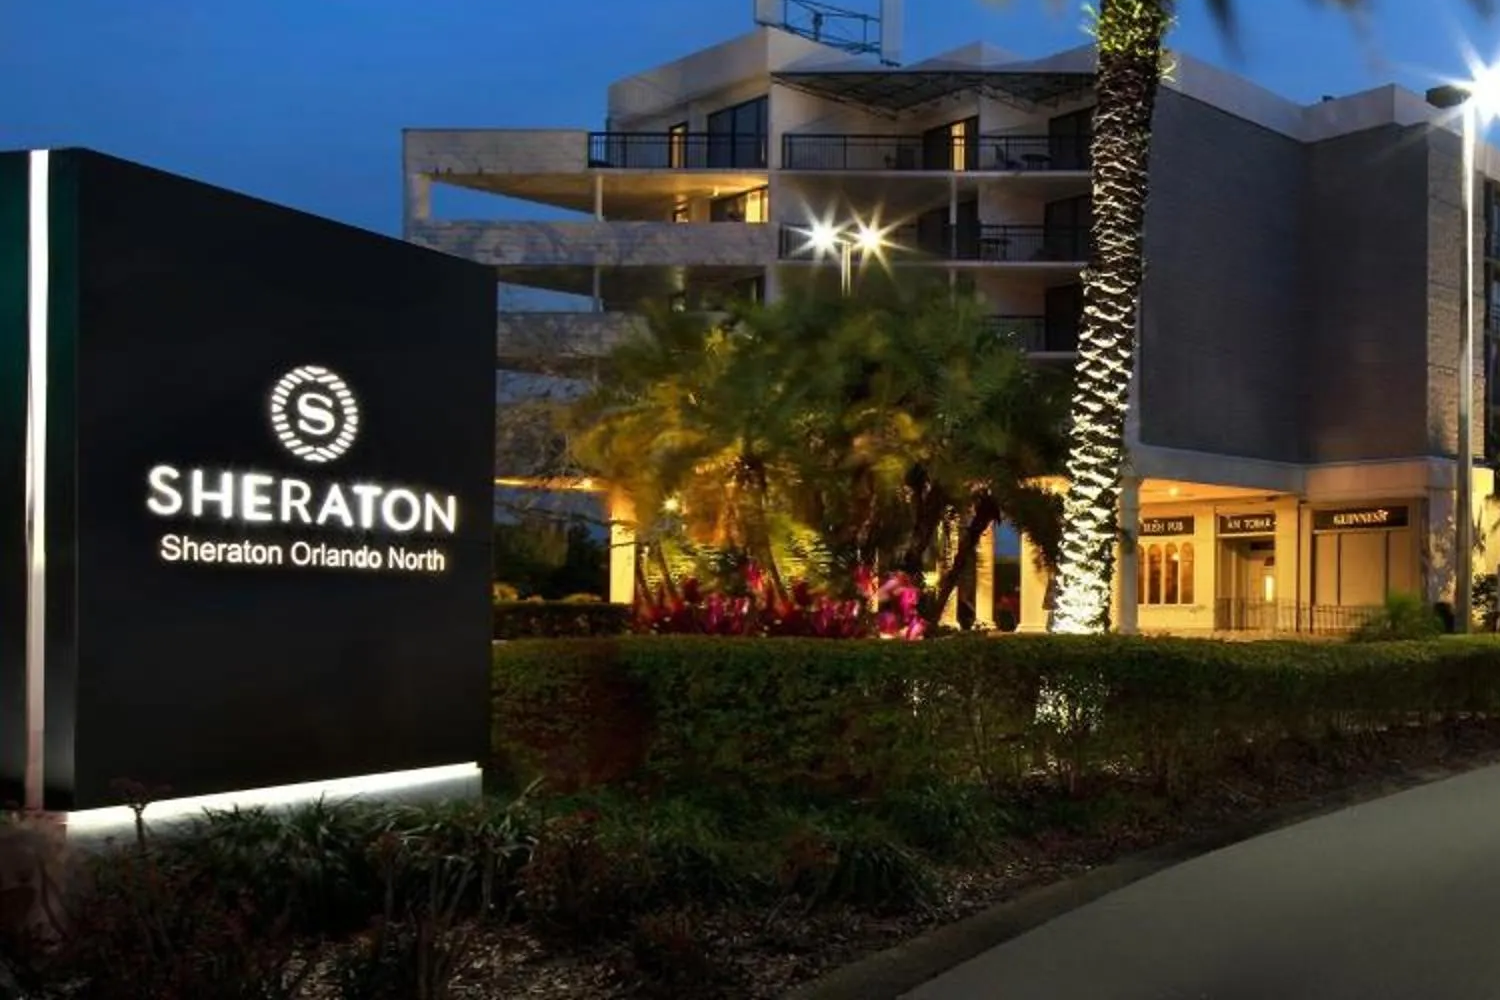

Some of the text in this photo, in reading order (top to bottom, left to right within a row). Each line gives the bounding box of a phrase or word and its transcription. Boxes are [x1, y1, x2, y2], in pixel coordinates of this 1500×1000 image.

[297, 393, 335, 435] S
[147, 465, 456, 533] SHERATON
[161, 534, 445, 571] Sheraton Orlando North
